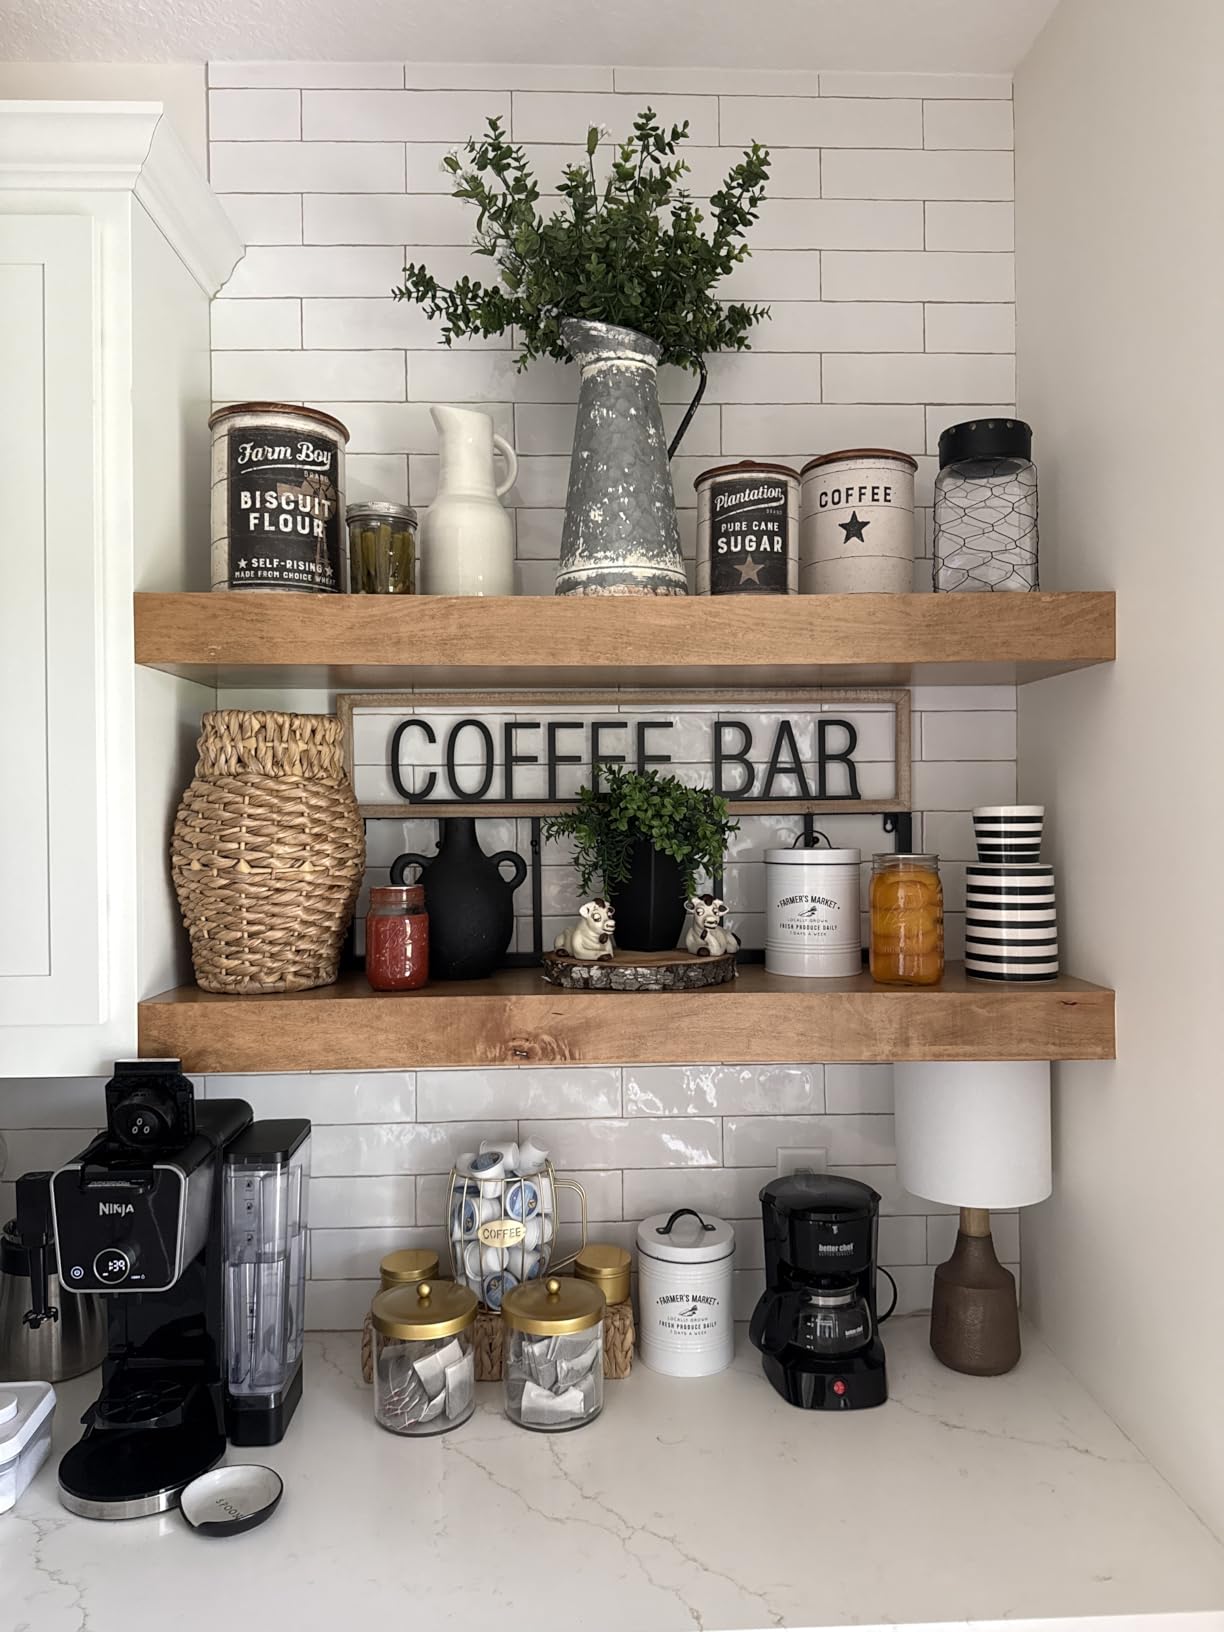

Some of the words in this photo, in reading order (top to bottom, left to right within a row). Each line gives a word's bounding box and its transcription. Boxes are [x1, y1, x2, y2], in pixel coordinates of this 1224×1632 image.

[238, 442, 292, 464] Farm
[296, 442, 331, 465] Boy
[240, 491, 331, 518] BISCUIT
[714, 484, 784, 511] Plantation
[819, 486, 893, 508] COFFEE
[249, 512, 324, 538] FLOUR
[721, 521, 748, 532] PURE
[752, 521, 779, 532] CANE
[717, 535, 783, 554] SUGAR
[251, 558, 323, 573] SELF-RISING
[235, 570, 255, 578] MADE
[283, 571, 312, 581] CHOICE
[714, 719, 861, 800] BAR
[779, 895, 809, 908] FARMER'S
[811, 895, 838, 909] MARKET
[99, 1202, 134, 1217] NINJA
[482, 1226, 521, 1240] COFFEE
[659, 1294, 690, 1305] FARMER'S
[692, 1294, 717, 1305] MARKET
